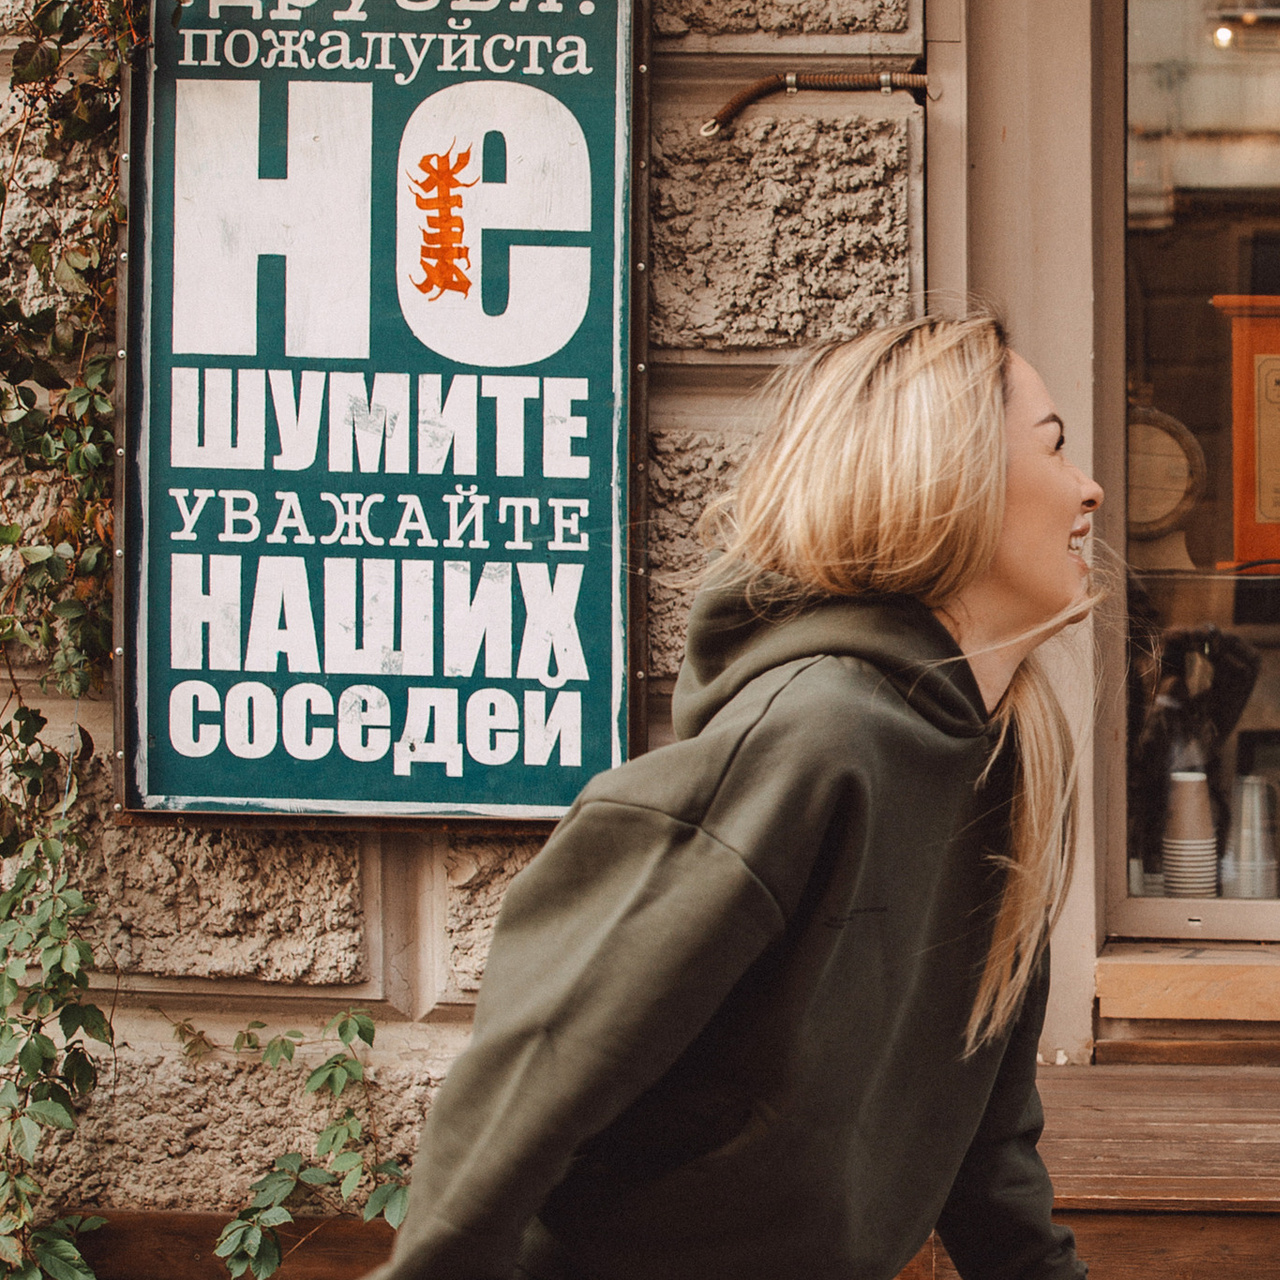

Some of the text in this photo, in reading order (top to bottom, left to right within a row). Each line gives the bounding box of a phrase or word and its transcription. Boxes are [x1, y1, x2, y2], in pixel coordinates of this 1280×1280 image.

[177, 18, 594, 86] пожалуйста
[170, 368, 591, 478] ШУМИТЕ
[169, 483, 590, 551] УВАЖАЙТЕ
[170, 552, 591, 682] НАШИХ
[169, 670, 583, 778] соседей
